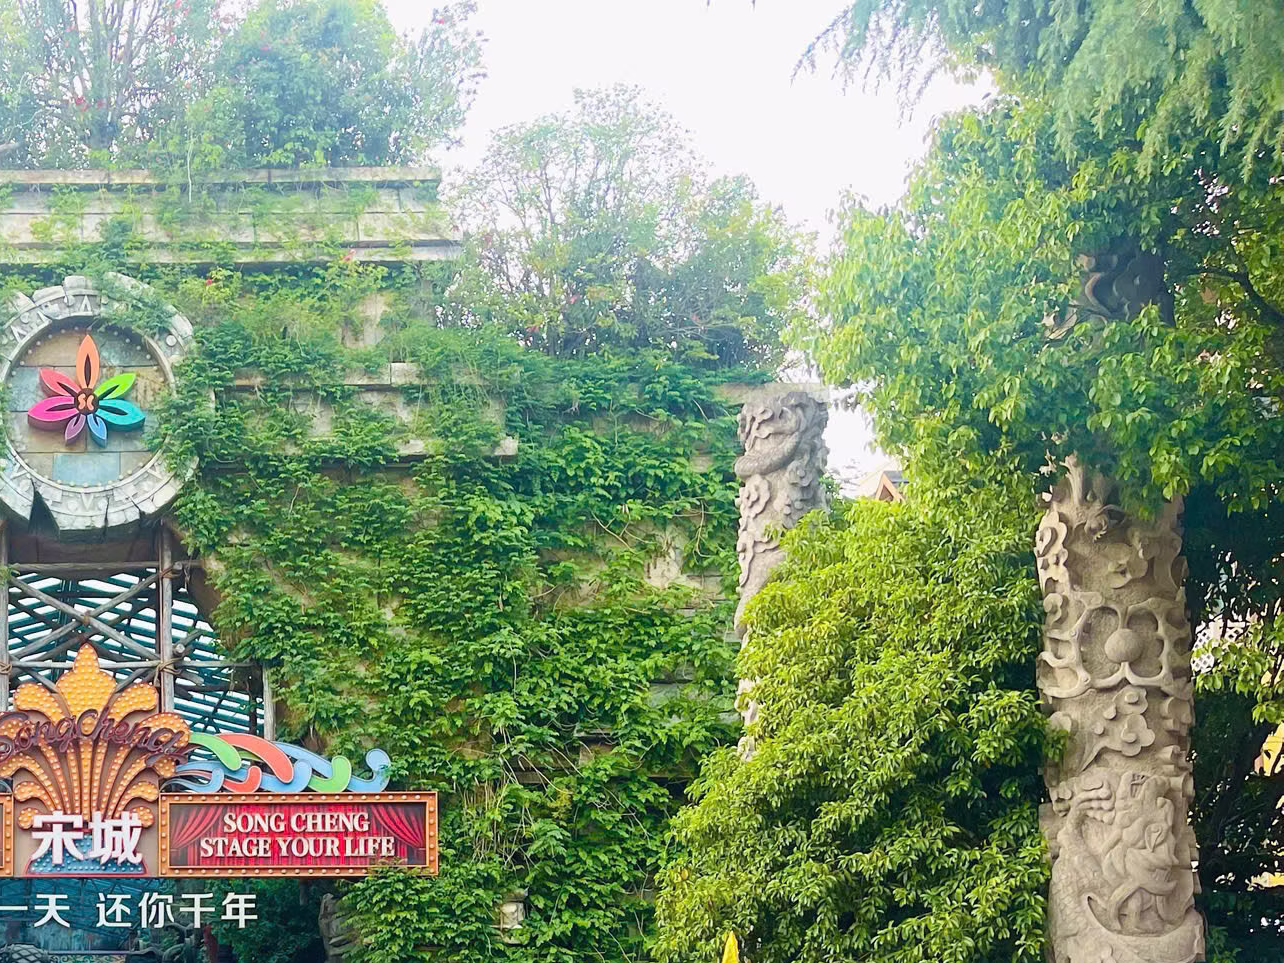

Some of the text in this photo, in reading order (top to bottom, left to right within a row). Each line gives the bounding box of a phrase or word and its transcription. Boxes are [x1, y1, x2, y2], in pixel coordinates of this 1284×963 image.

[223, 812, 370, 833] SONG CHENG
[31, 810, 143, 865] 宋城
[200, 836, 395, 858] STAGE YOUR LIFE
[96, 892, 258, 929] 还你千年
